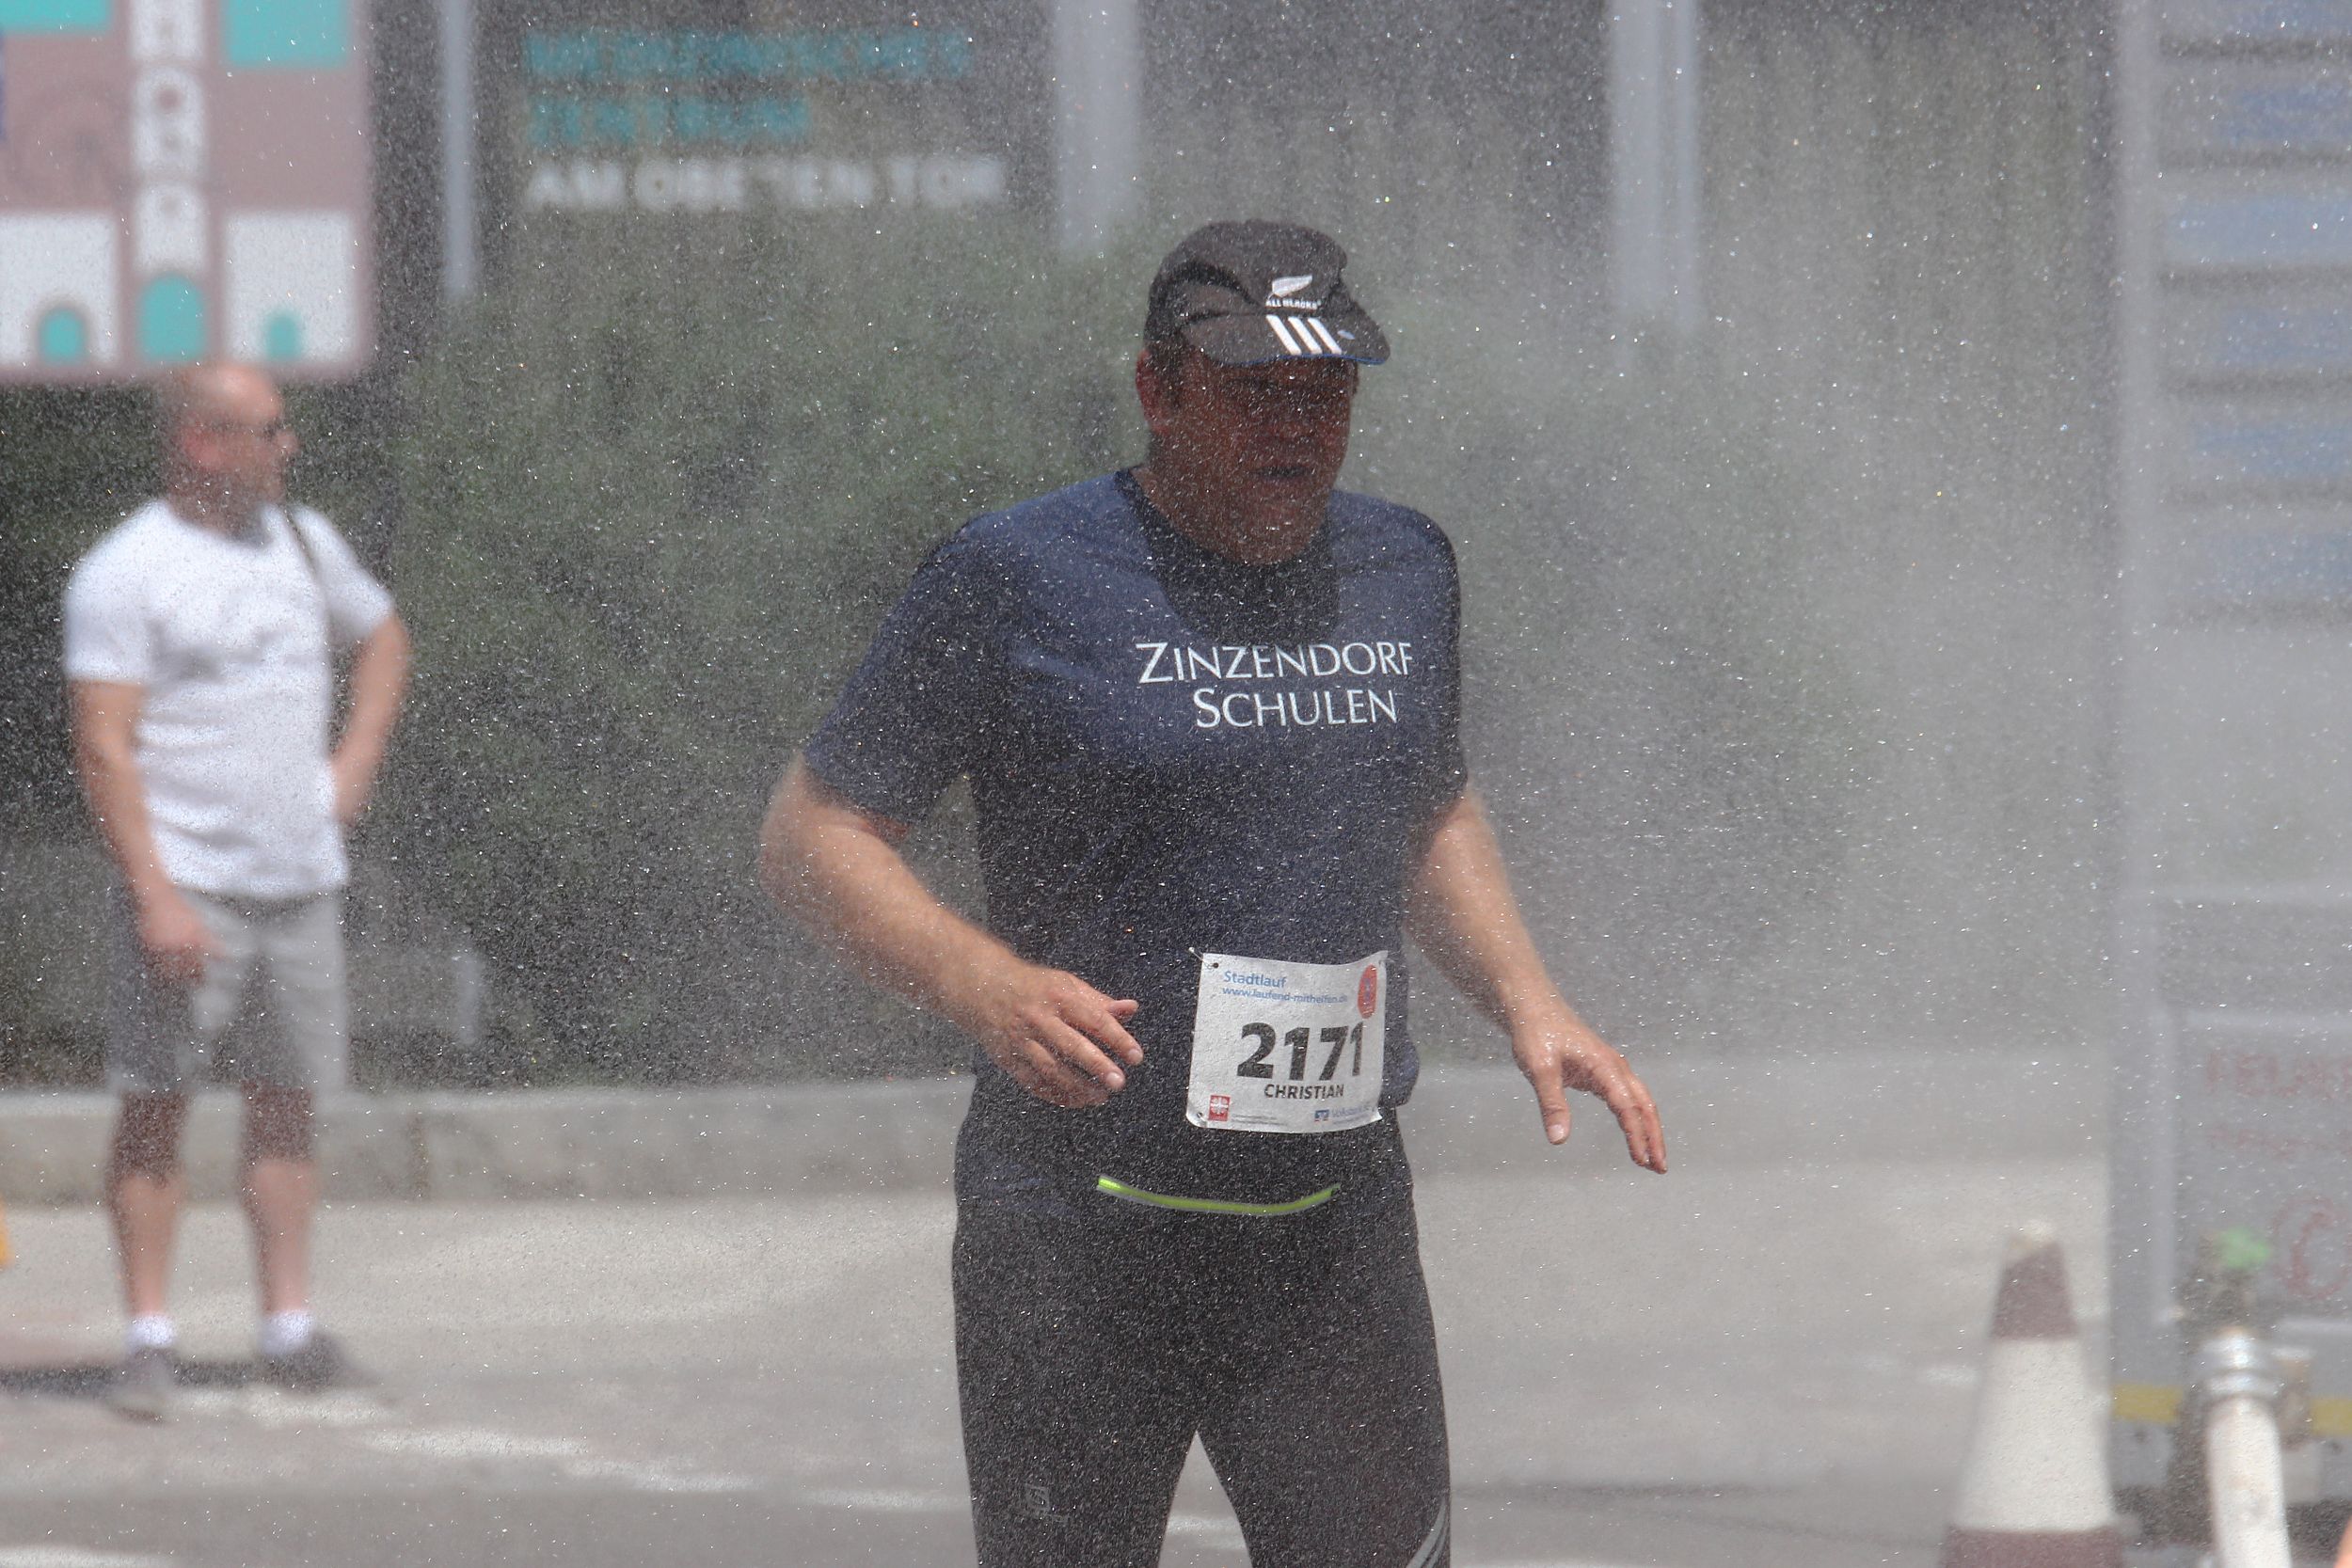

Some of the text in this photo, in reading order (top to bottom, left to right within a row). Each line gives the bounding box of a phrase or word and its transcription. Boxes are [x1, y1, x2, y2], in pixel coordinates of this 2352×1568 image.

[1135, 642, 1412, 684] ZINZENDORF
[1192, 688, 1397, 728] SCHULEN
[1223, 971, 1287, 988] Stadtlauf
[1236, 1022, 1364, 1082] 2171
[1263, 1084, 1345, 1100] CHRISTIAN
